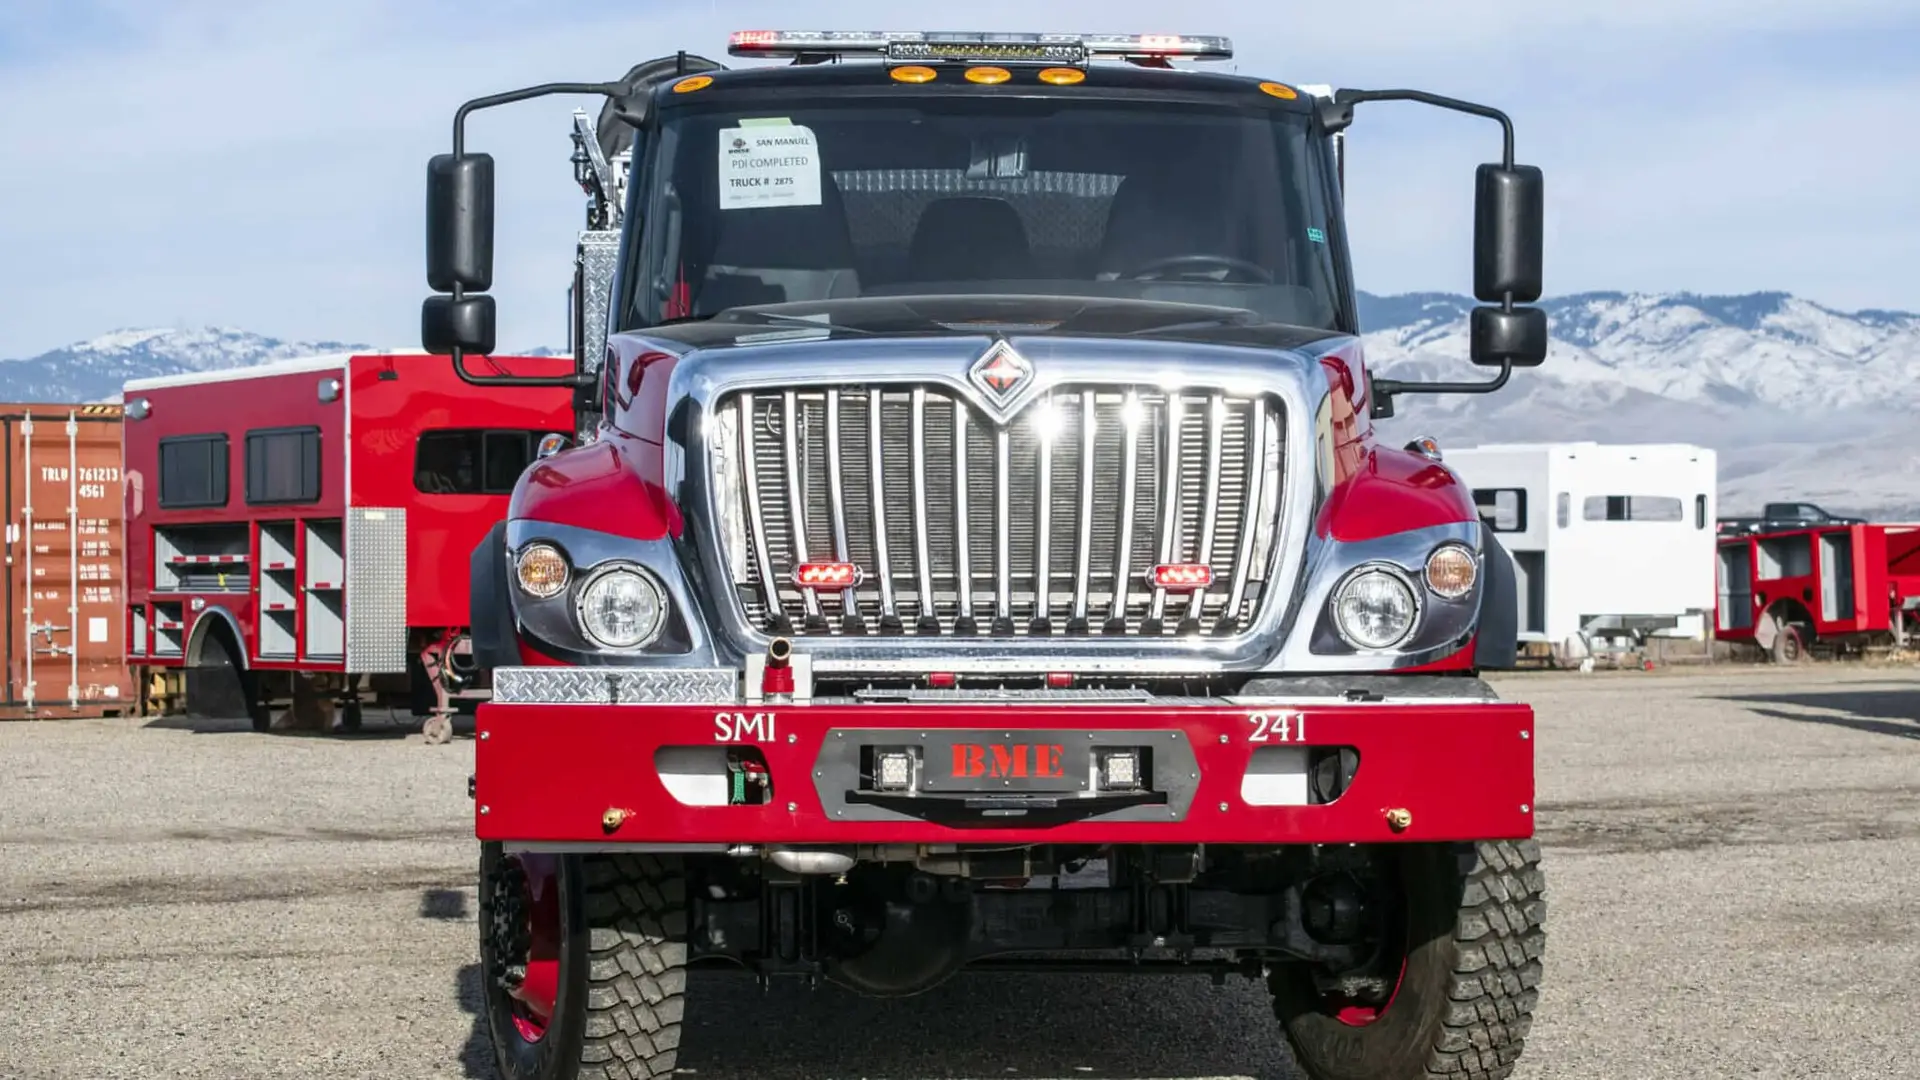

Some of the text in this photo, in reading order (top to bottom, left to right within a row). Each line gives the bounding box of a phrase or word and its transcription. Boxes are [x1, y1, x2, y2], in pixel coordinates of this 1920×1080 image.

[756, 137, 809, 146] SAN MANUEL
[732, 157, 808, 169] PDI COMPLETED
[730, 178, 761, 187] TRUCK
[774, 177, 794, 186] 2875
[42, 467, 118, 481] TRLU 761213
[714, 712, 776, 742] SMI
[1248, 711, 1306, 742] 241
[951, 743, 1065, 778] BME
